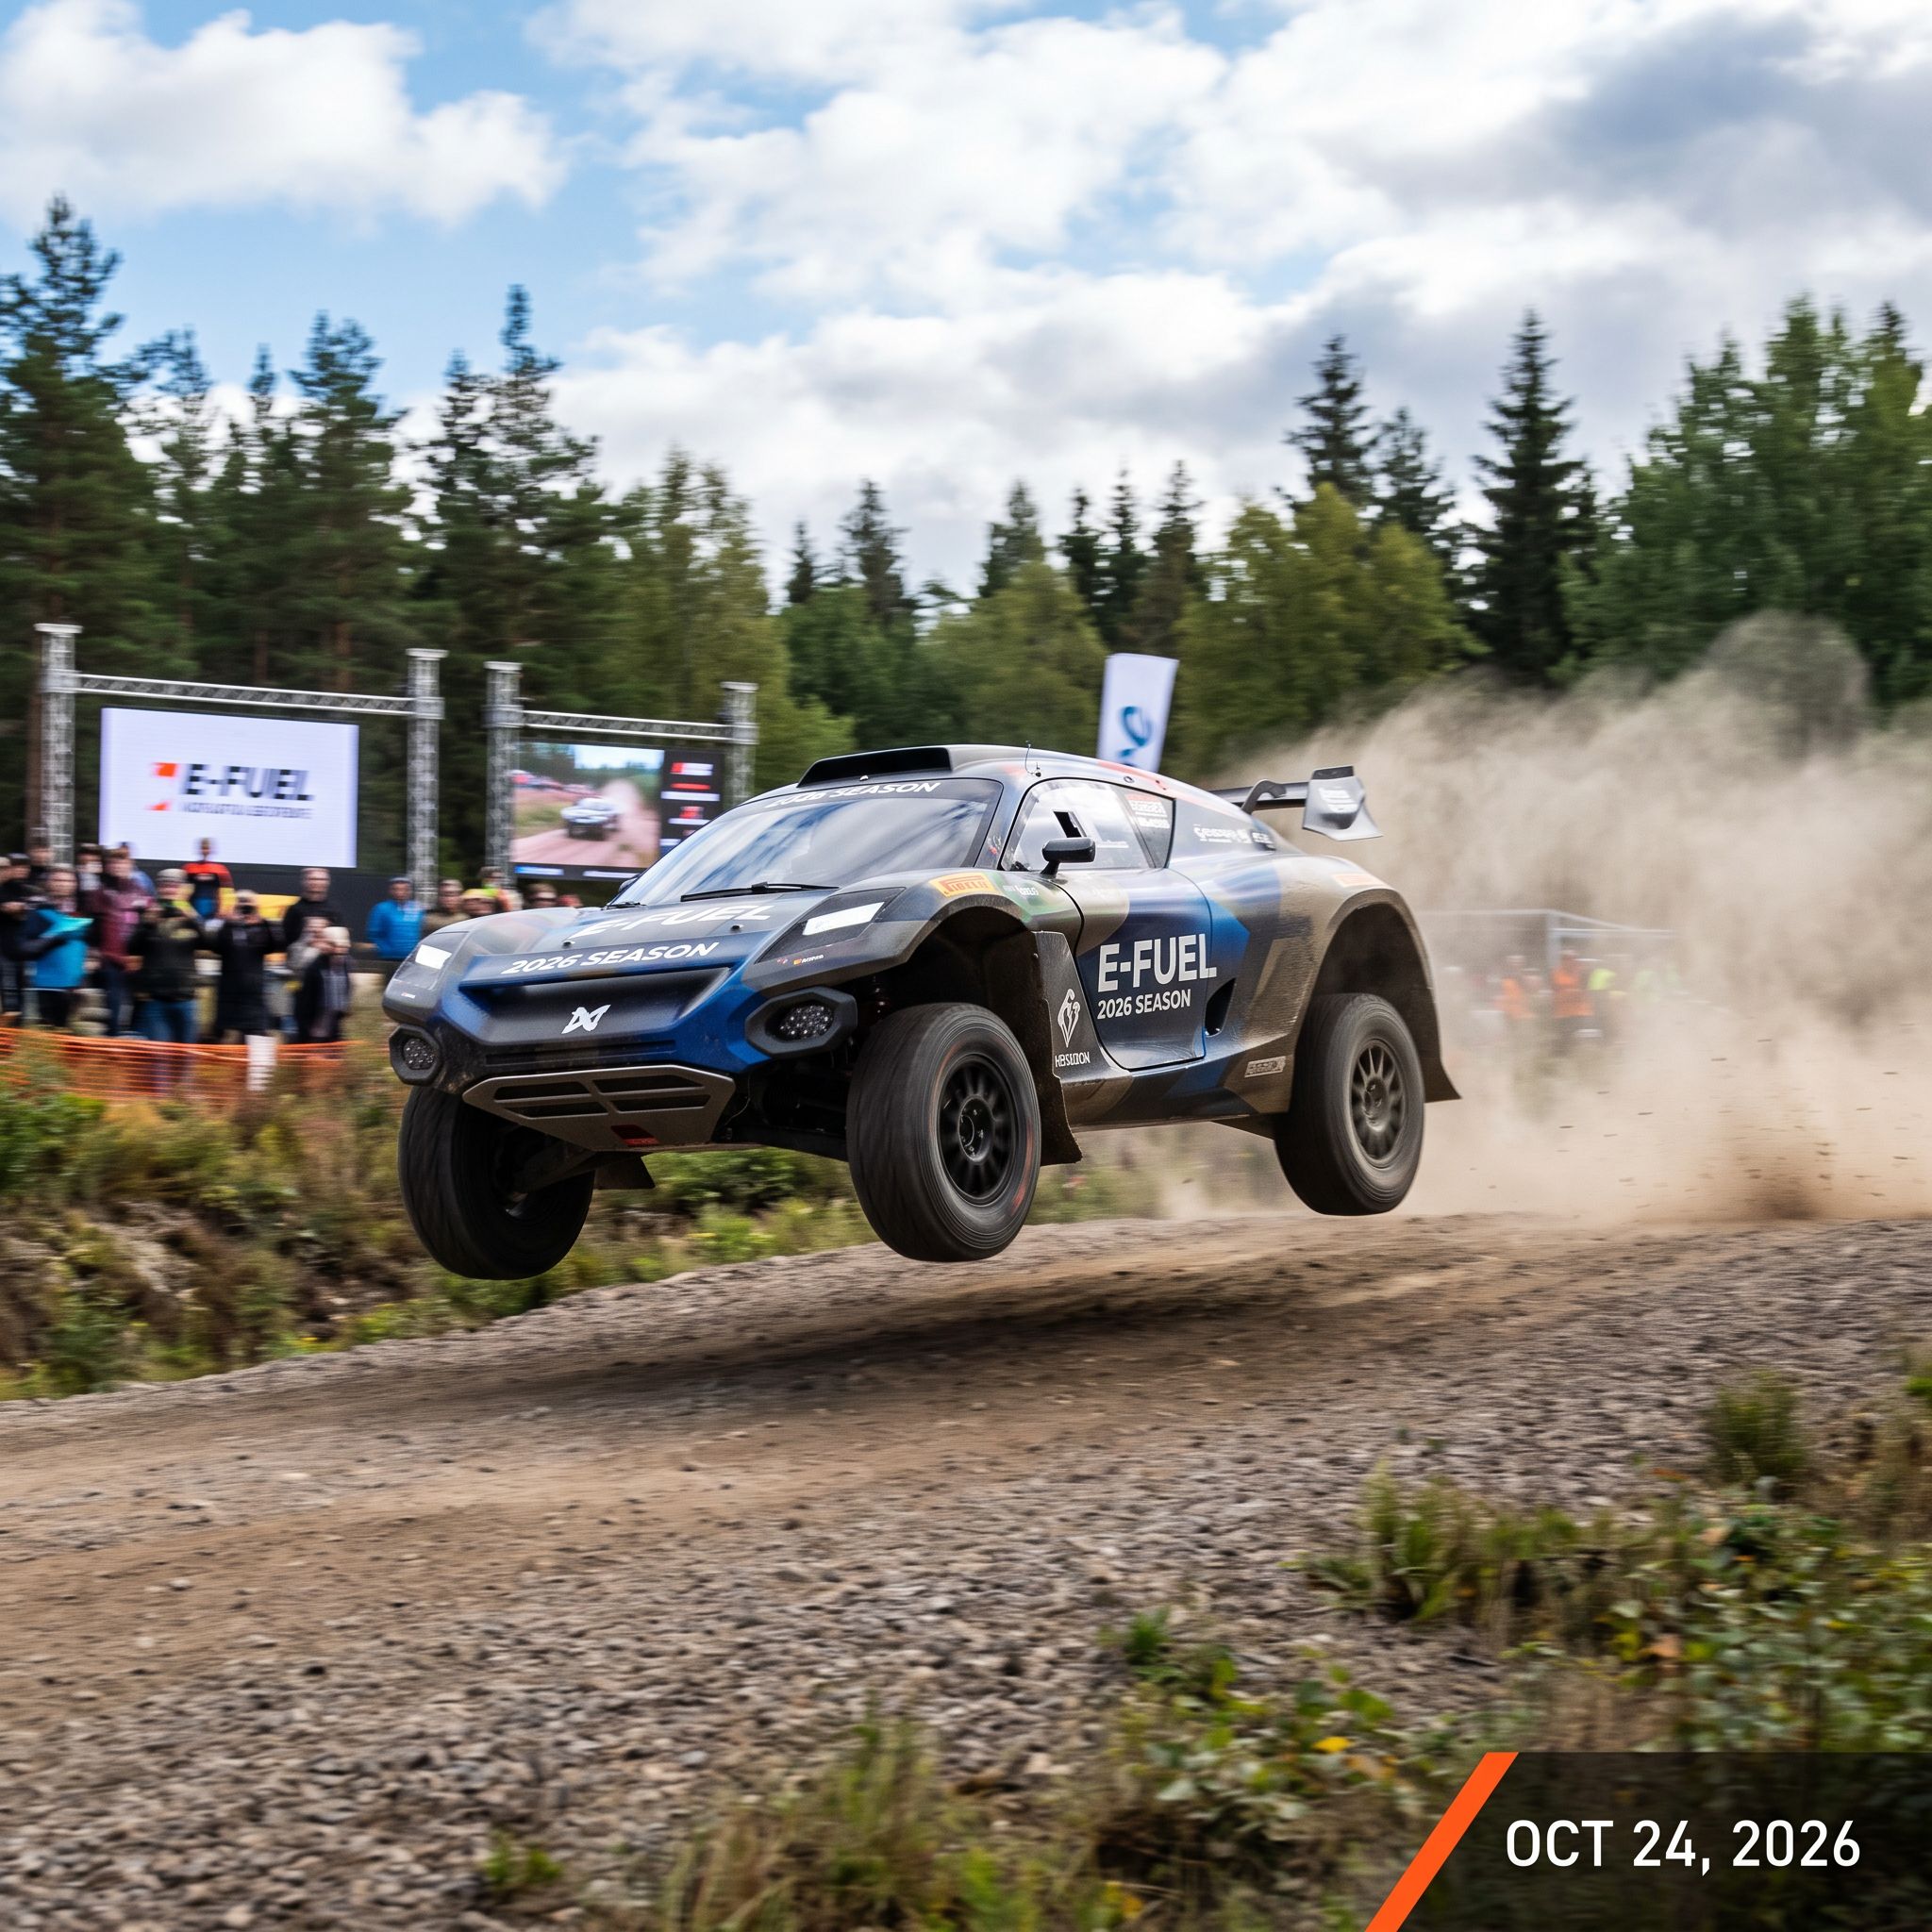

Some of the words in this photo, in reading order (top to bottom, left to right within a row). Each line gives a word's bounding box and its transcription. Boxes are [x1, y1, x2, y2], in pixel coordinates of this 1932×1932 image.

[179, 762, 314, 801] E-FUEL
[828, 782, 941, 798] SEASON
[568, 905, 775, 939] E-FUEL
[500, 953, 577, 974] 2026
[579, 941, 720, 966] SEASON
[1097, 933, 1218, 993] E-FUEL
[1096, 996, 1132, 1020] 2026
[1135, 989, 1191, 1015] SEASON
